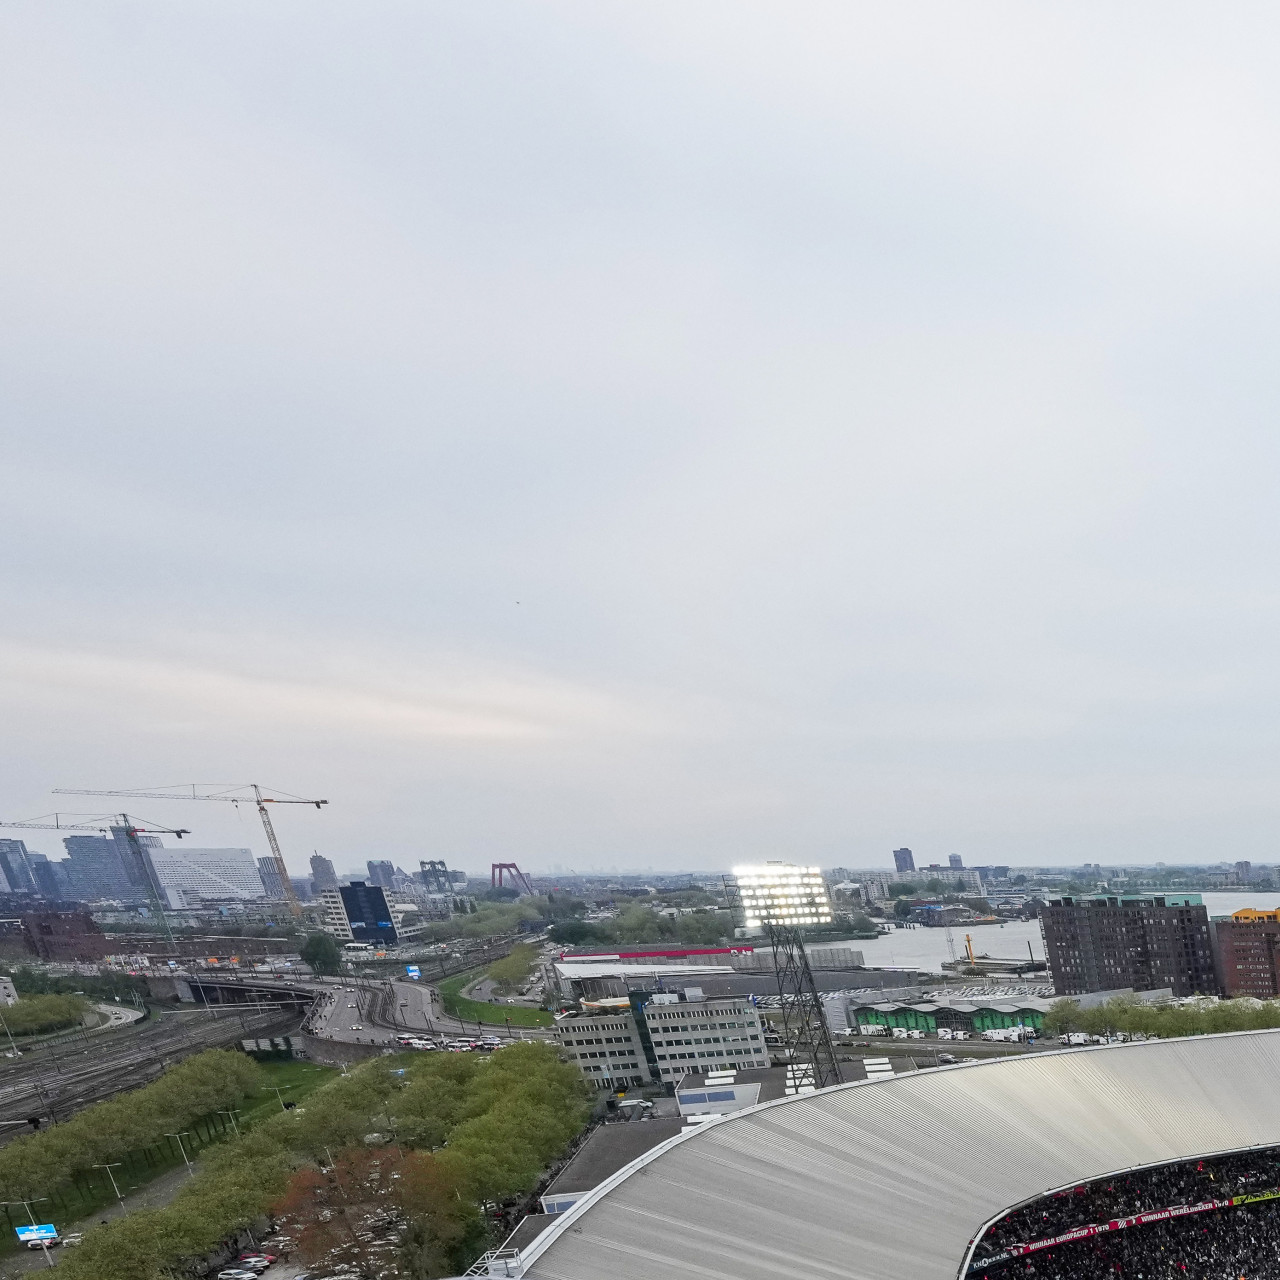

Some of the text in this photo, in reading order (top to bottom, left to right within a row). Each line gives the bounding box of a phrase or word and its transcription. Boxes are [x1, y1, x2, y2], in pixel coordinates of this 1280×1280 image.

[1141, 1212, 1170, 1222] WINNAAR
[1029, 1239, 1055, 1250] WINNAAR
[1056, 1230, 1089, 1242] EUROPACUP
